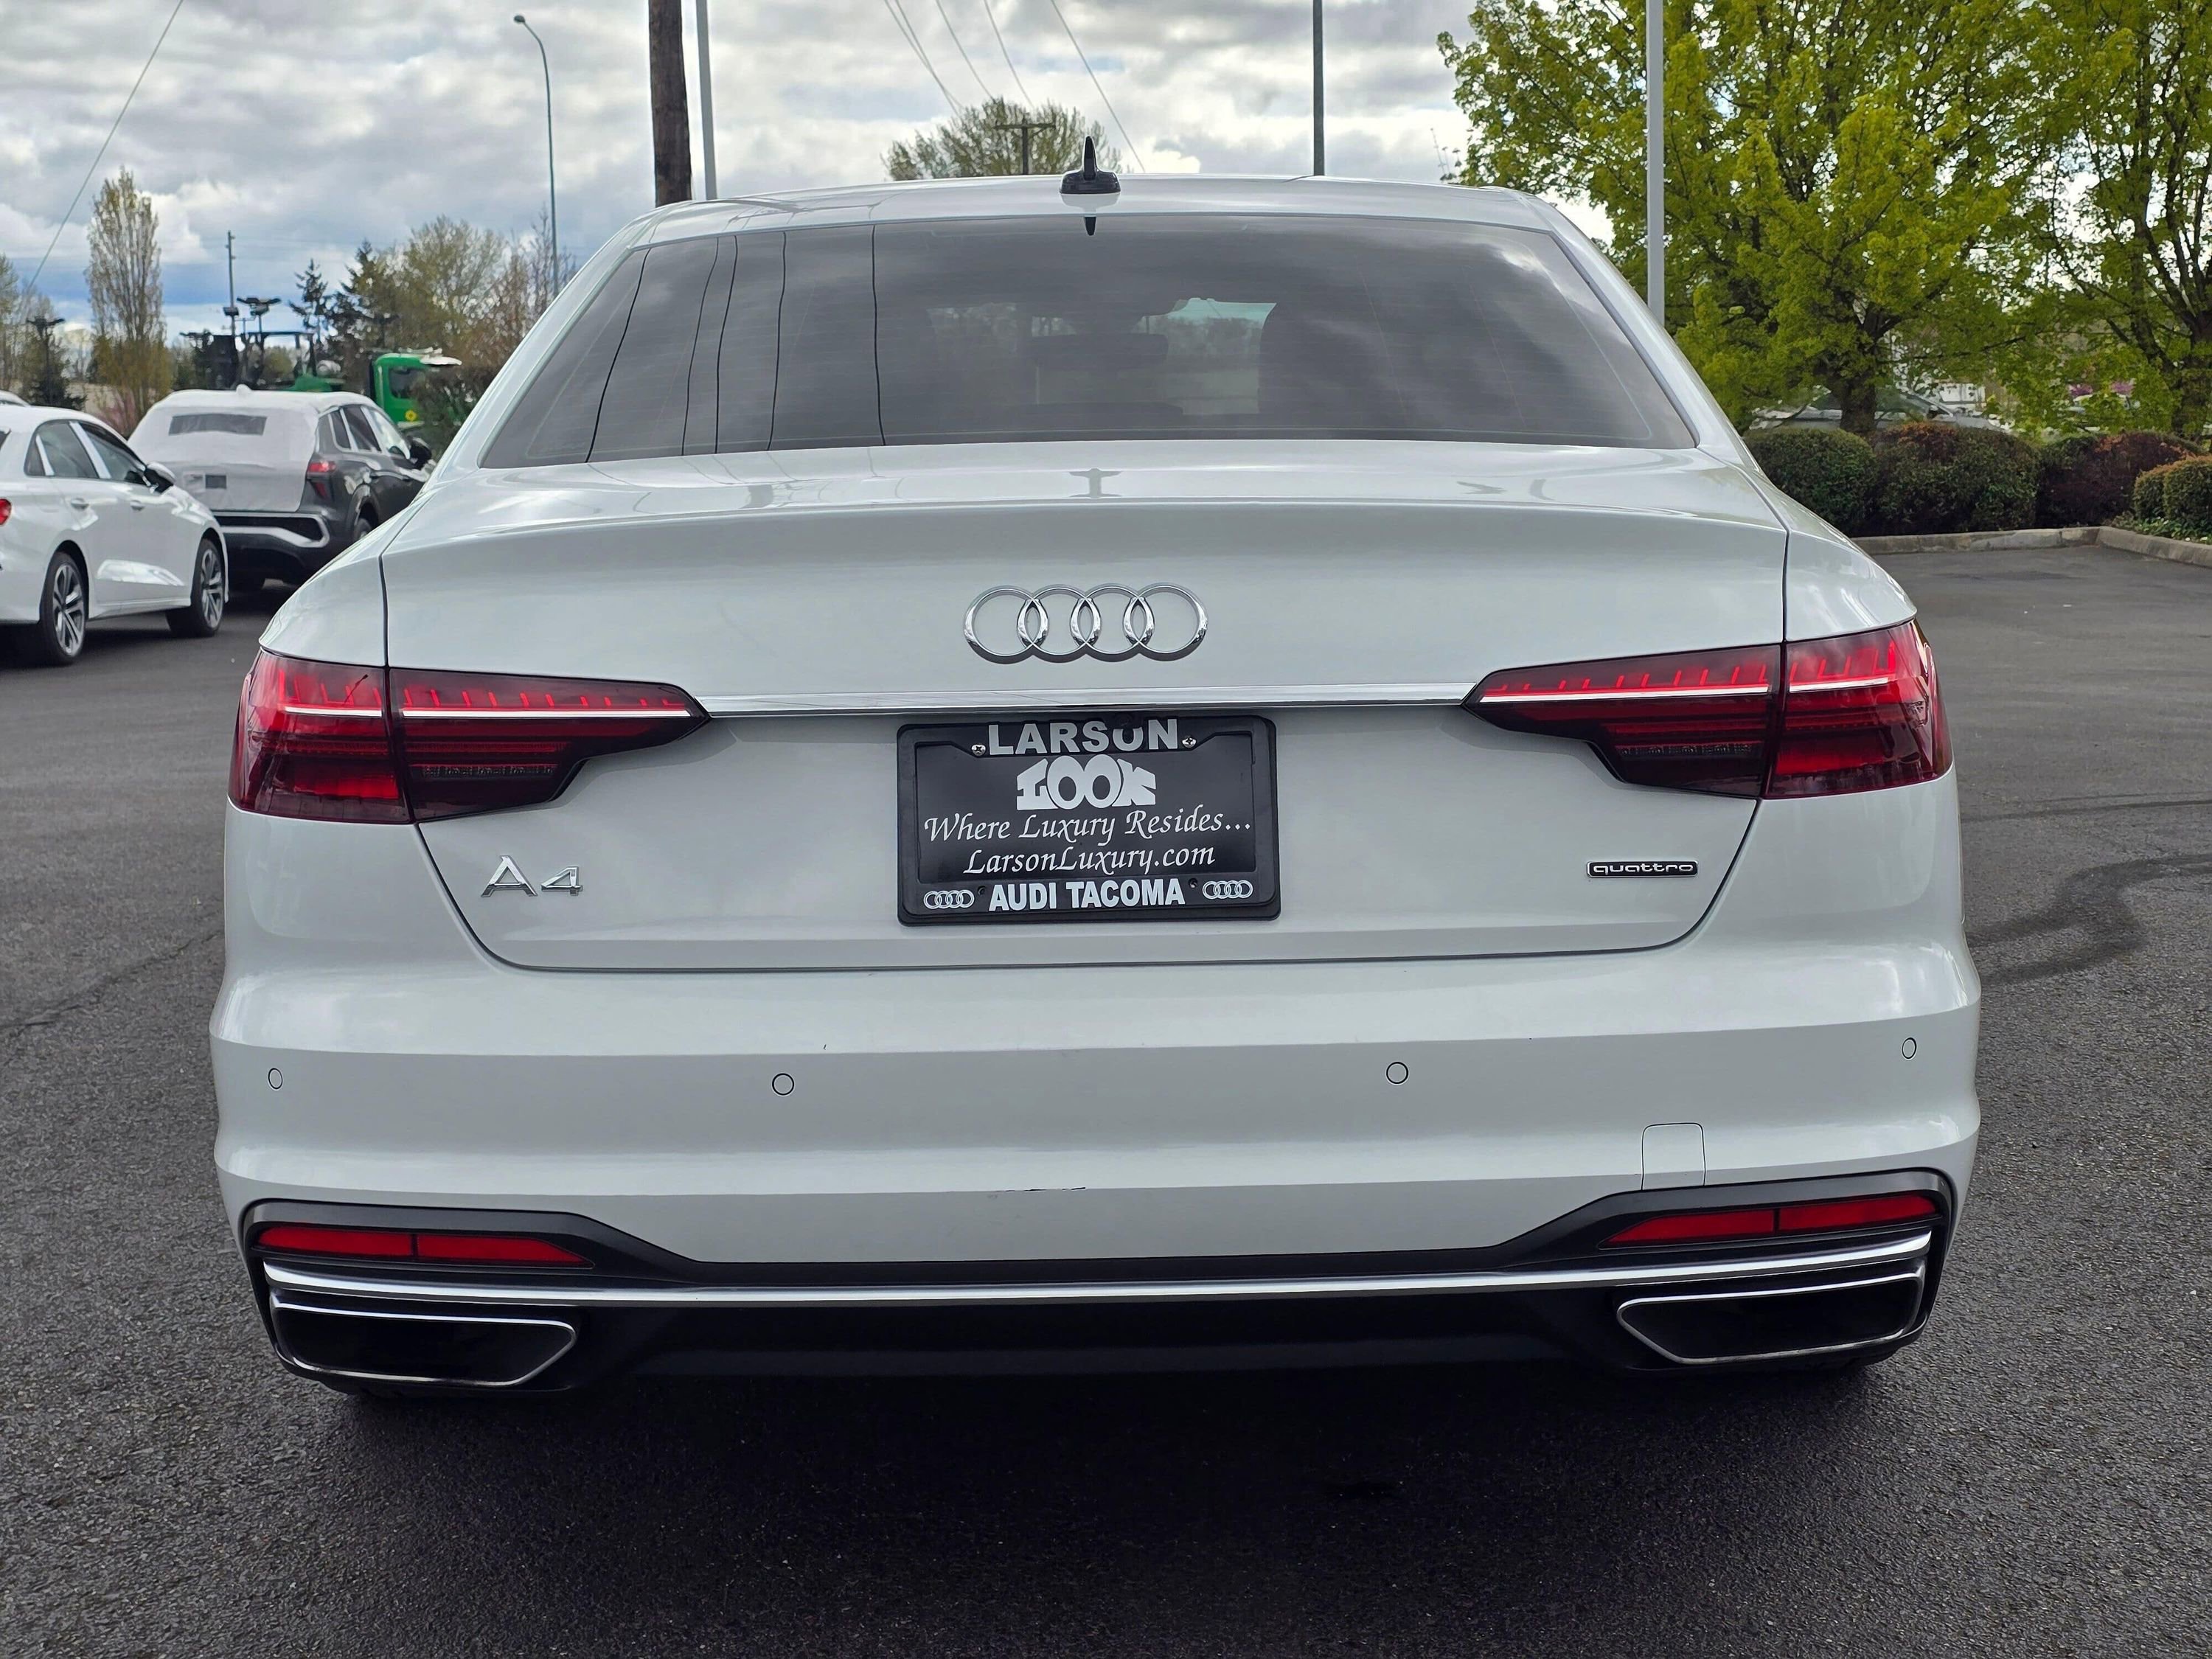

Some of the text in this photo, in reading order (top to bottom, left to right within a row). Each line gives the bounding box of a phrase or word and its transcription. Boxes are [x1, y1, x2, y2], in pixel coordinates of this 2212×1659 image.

[988, 719, 1178, 755] LARSON
[1016, 754, 1156, 810] LOOK
[924, 804, 1251, 846] Where Luxury Resides...
[481, 855, 583, 897] A4
[963, 842, 1216, 876] LarsonLuxury.com
[1593, 863, 1694, 874] quattro
[988, 879, 1185, 911] AUDI TACOMA
